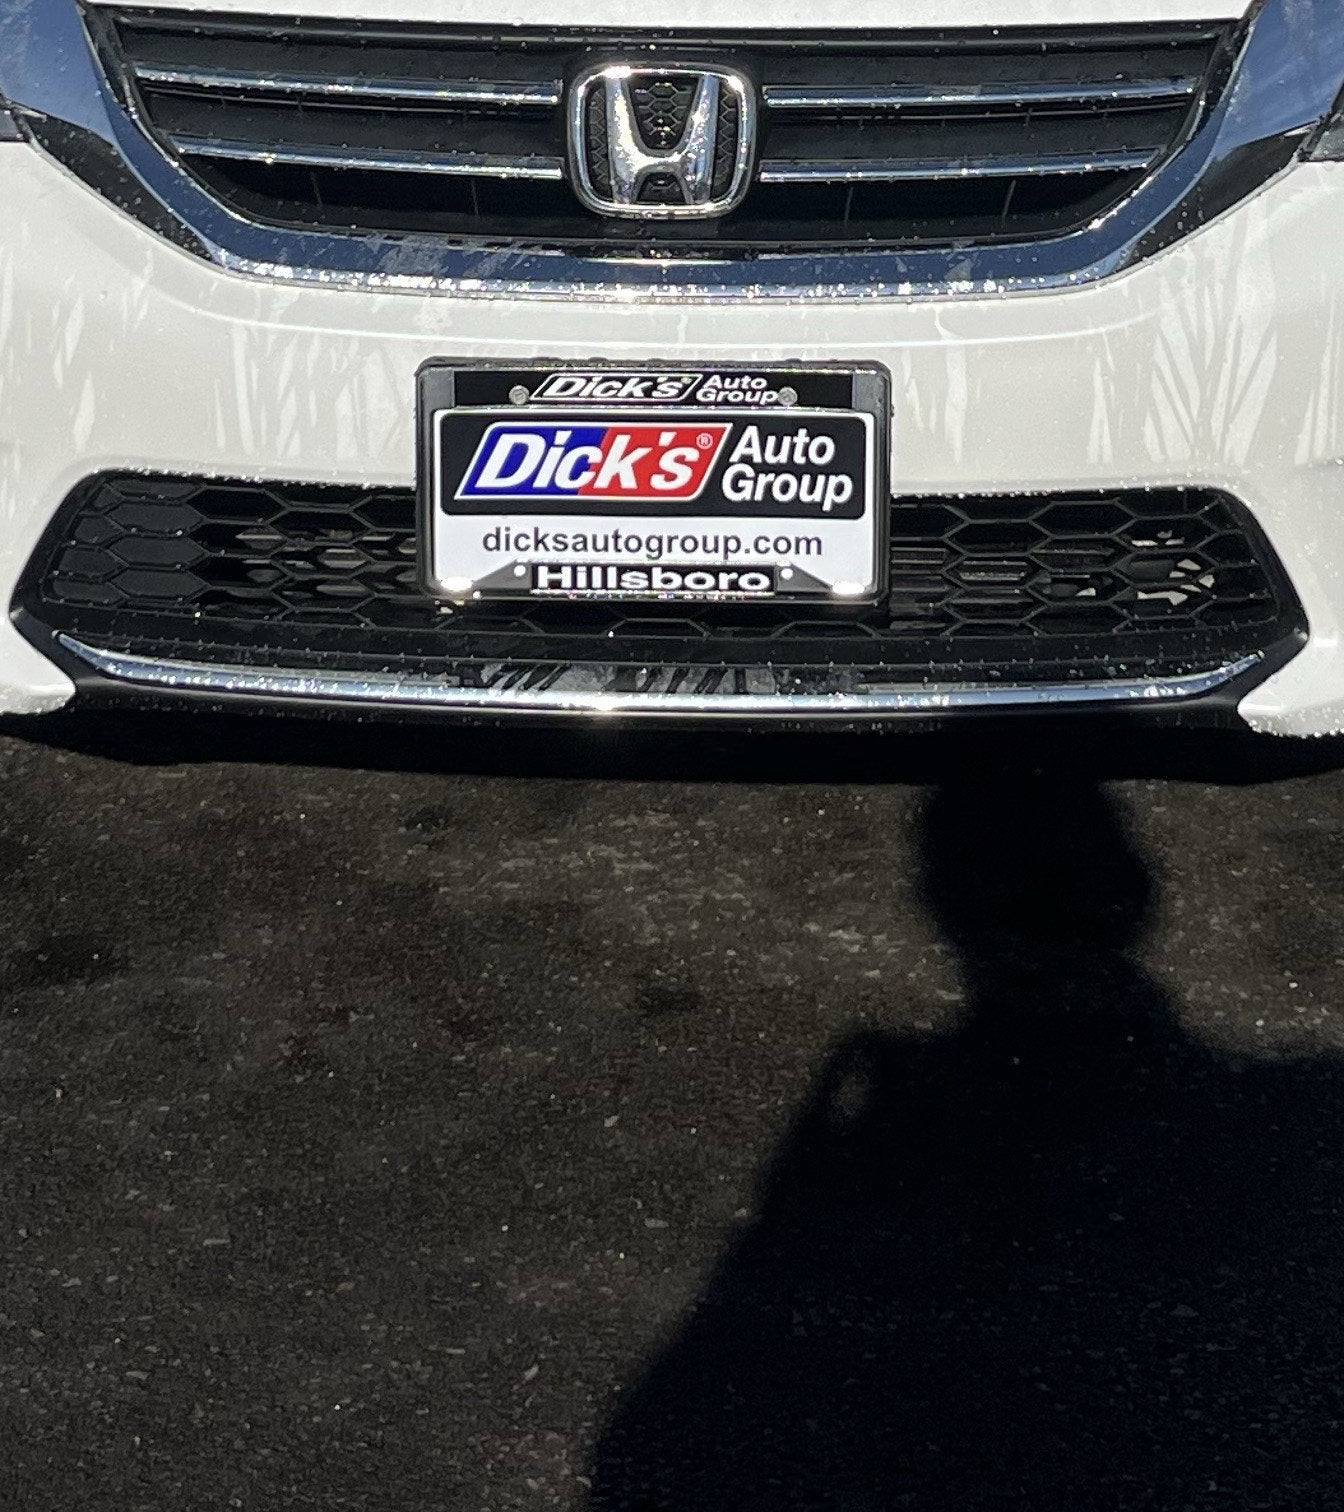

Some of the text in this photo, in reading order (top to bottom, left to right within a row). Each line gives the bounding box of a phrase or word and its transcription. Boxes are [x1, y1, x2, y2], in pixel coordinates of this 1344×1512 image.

[695, 387, 779, 406] Group
[703, 374, 767, 390] Auto
[728, 425, 836, 466] Auto
[721, 462, 853, 511] Group
[482, 527, 823, 561] dicksautogroup.com
[536, 565, 772, 592] Hillsboro
